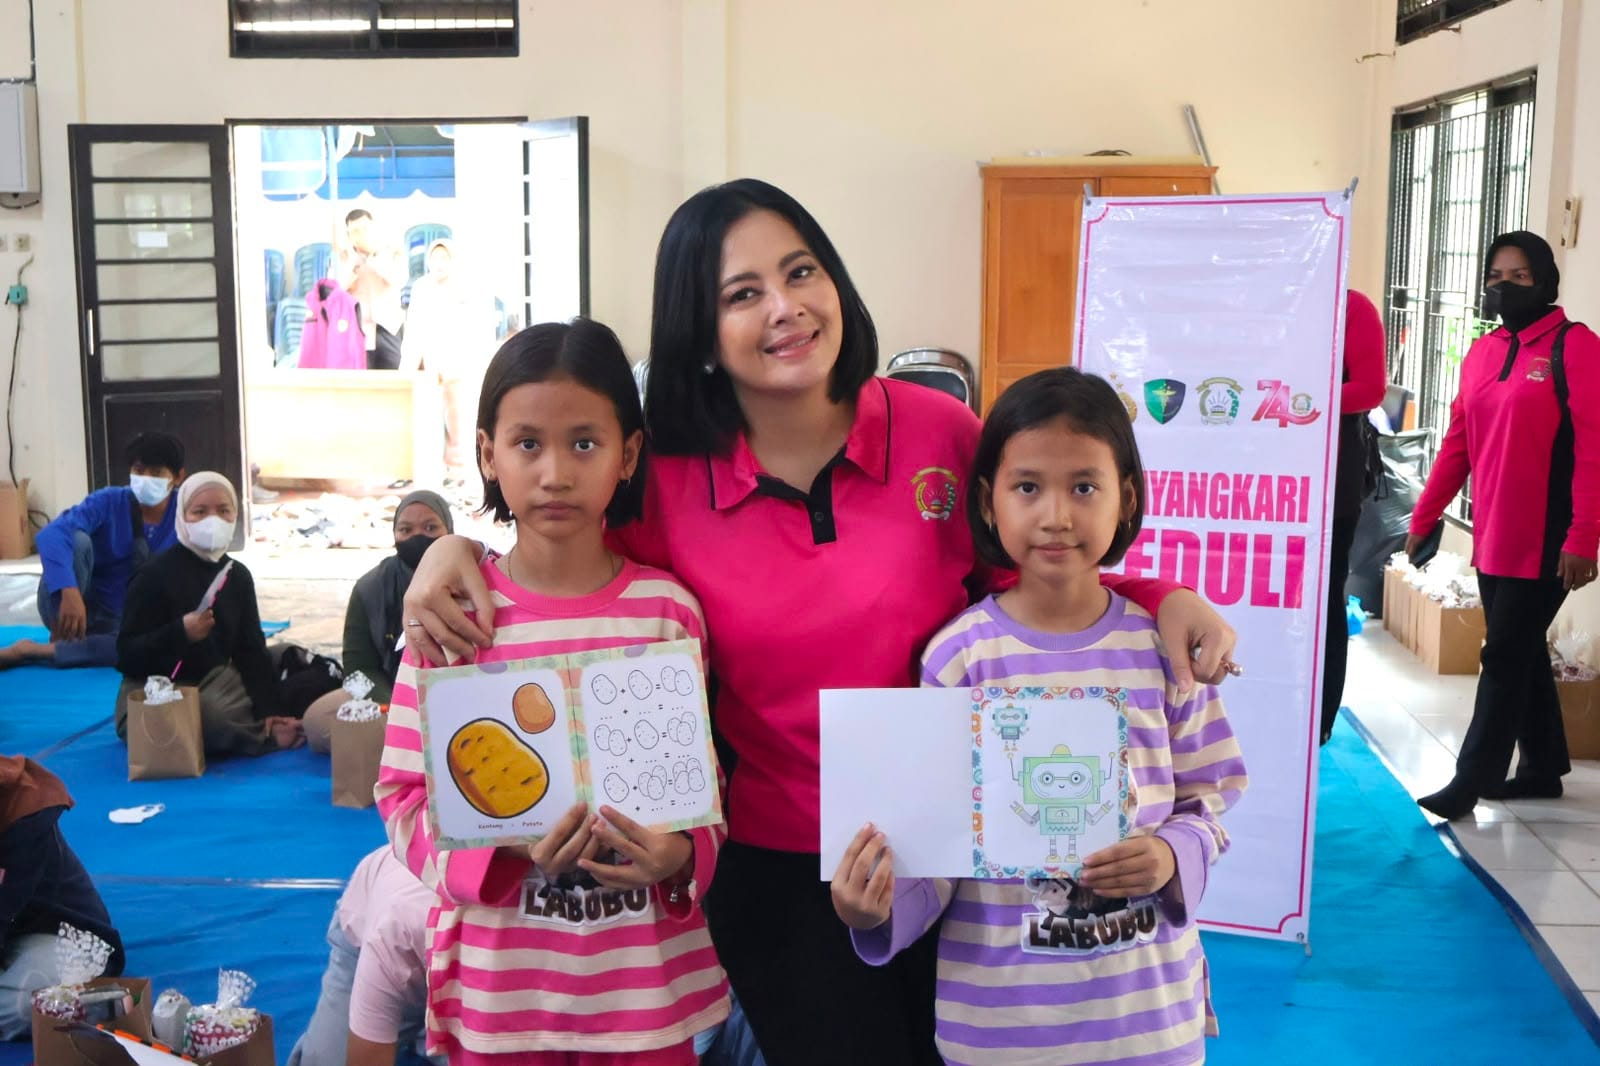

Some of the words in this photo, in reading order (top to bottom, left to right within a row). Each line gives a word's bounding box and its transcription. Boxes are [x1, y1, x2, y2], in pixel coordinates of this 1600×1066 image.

[1252, 380, 1295, 427] 74
[525, 884, 648, 922] LABUBU
[1029, 906, 1156, 949] LABUBU
